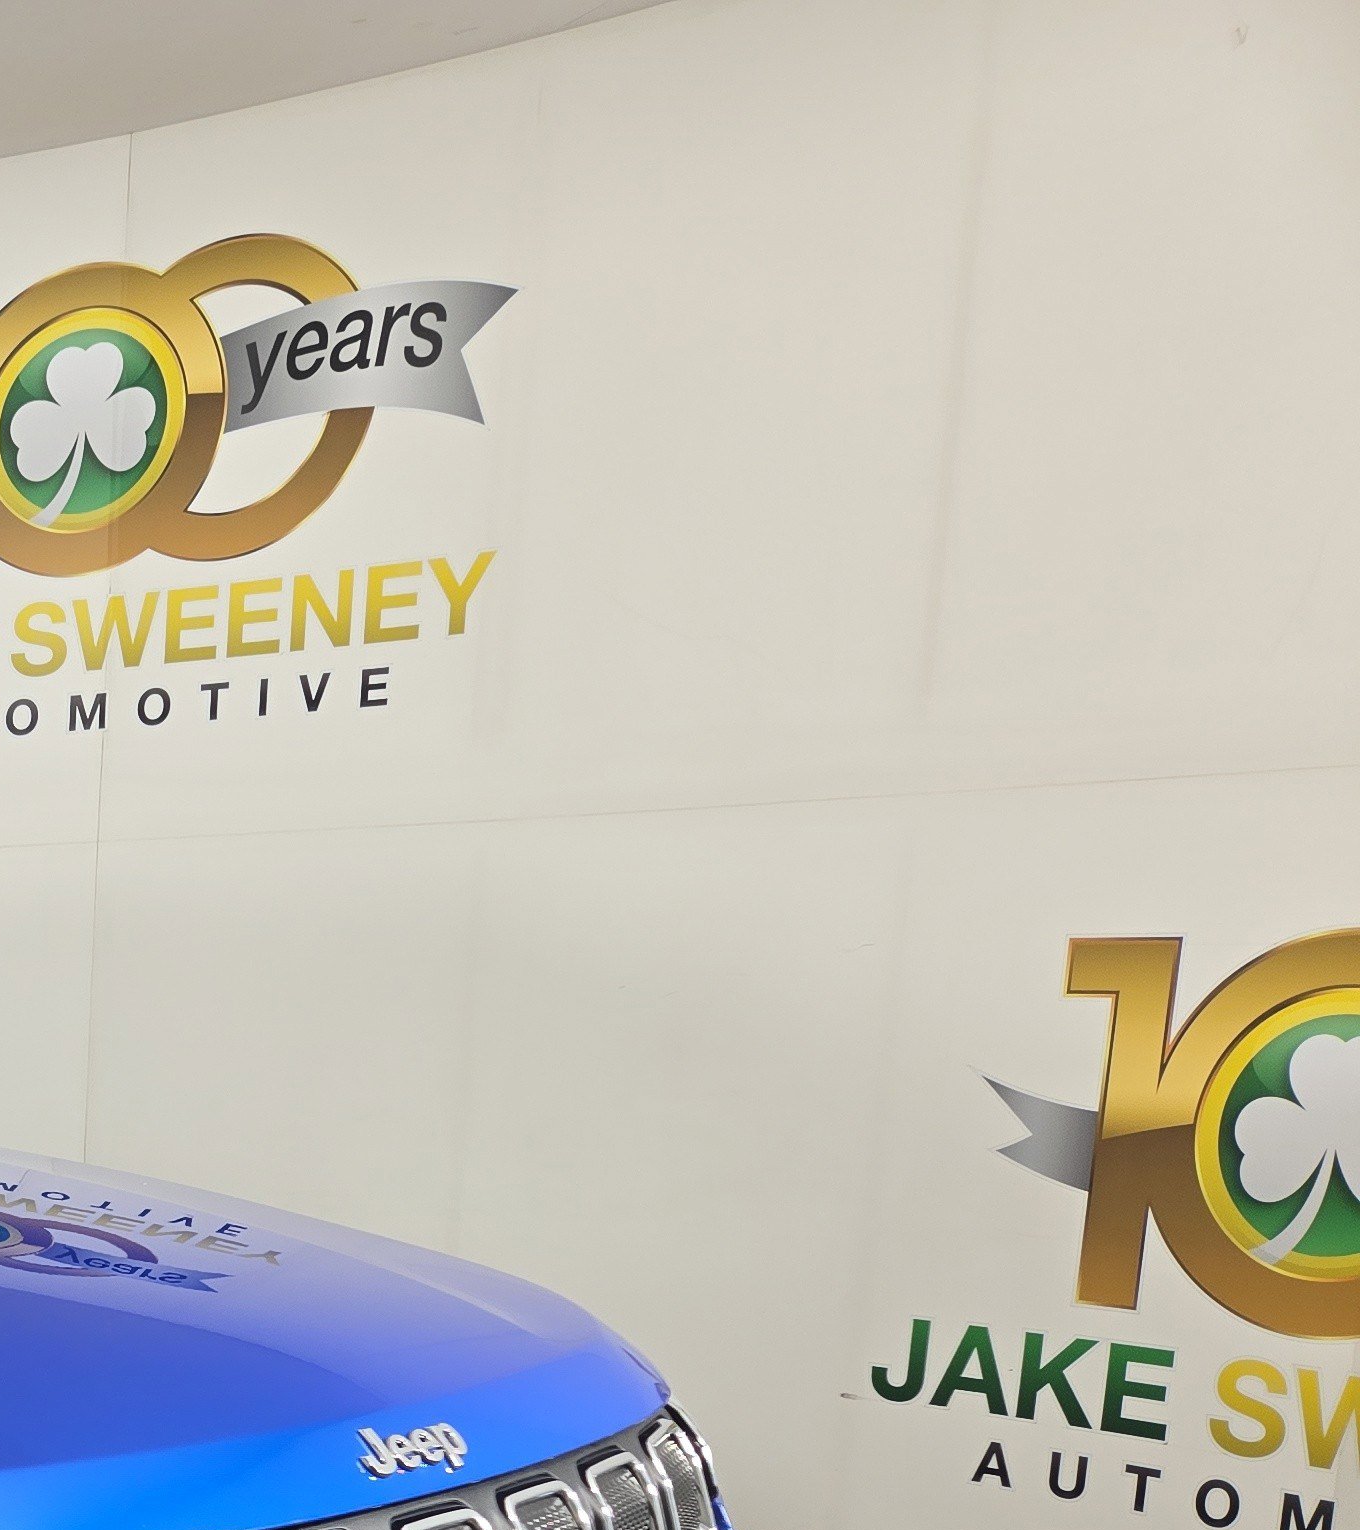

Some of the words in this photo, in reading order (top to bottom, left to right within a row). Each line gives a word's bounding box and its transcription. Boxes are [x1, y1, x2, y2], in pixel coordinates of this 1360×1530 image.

[241, 300, 447, 414] years
[10, 550, 497, 678] SWEENEY
[871, 1319, 1174, 1441] JAKE
[356, 1422, 468, 1477] Jeep
